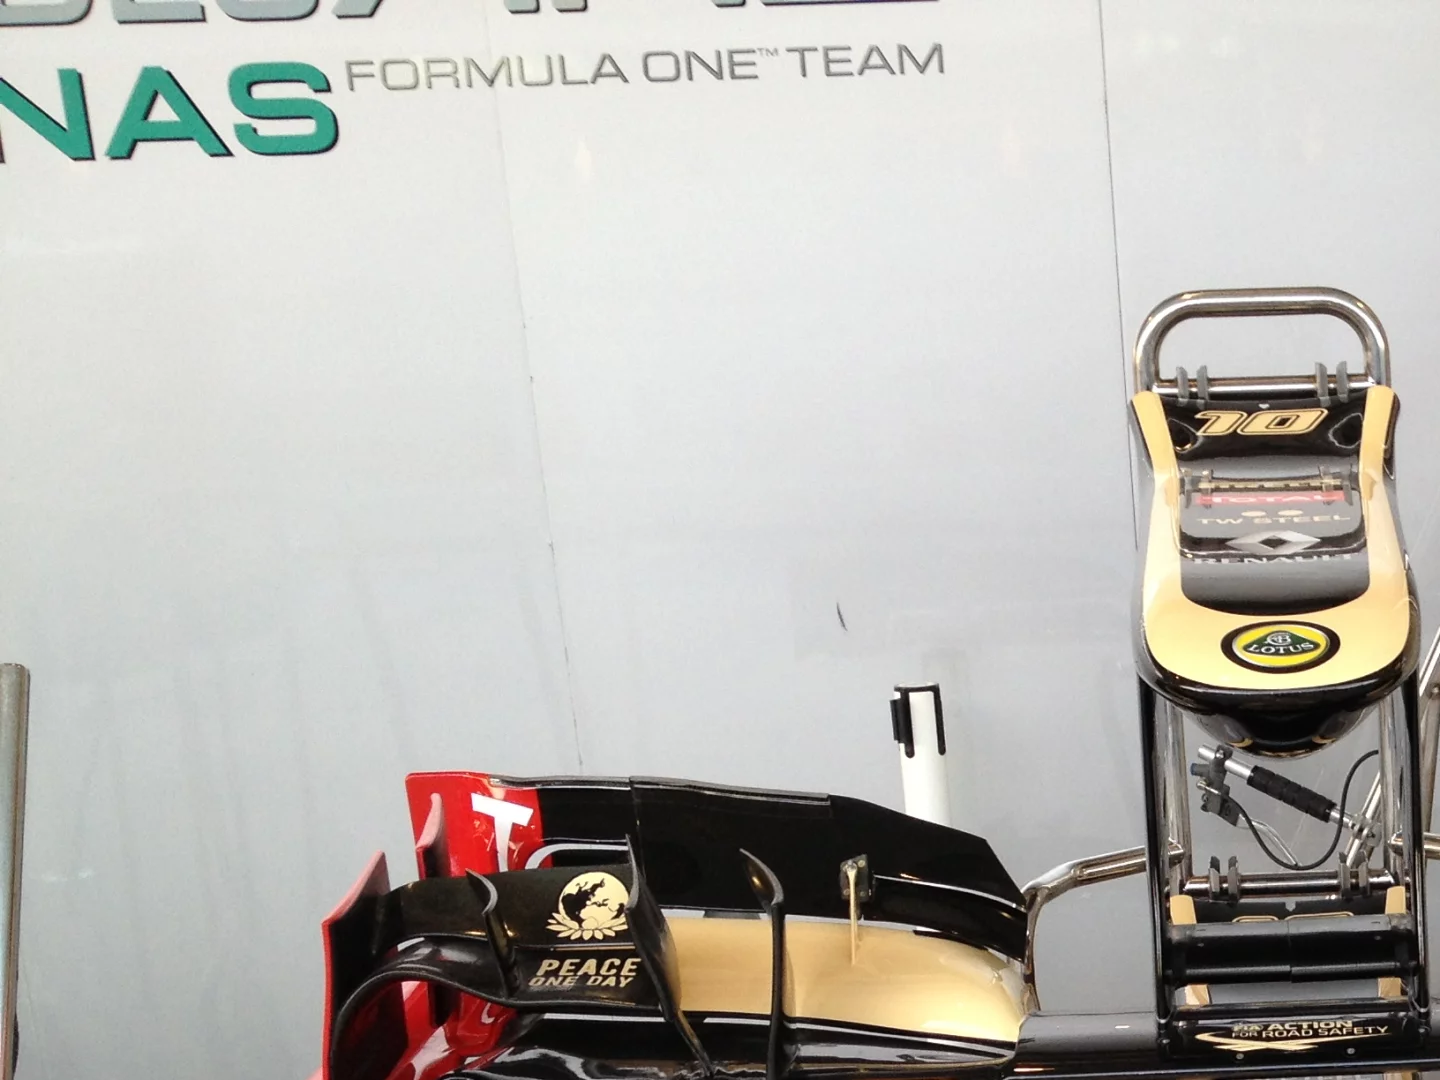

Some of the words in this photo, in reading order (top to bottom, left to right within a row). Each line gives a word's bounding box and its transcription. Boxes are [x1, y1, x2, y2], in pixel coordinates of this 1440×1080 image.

[345, 53, 630, 92] FORMULA
[785, 42, 945, 78] TEAM
[1194, 408, 1328, 436] 10
[1253, 515, 1350, 524] STEEL
[1247, 642, 1314, 654] LOTUS
[536, 958, 641, 976] PEACE
[528, 976, 579, 987] ONE
[586, 976, 634, 988] DAY
[1262, 1029, 1313, 1039] ROAD
[1318, 1025, 1389, 1036] SAFETY
[1267, 1020, 1353, 1031] ACTION
